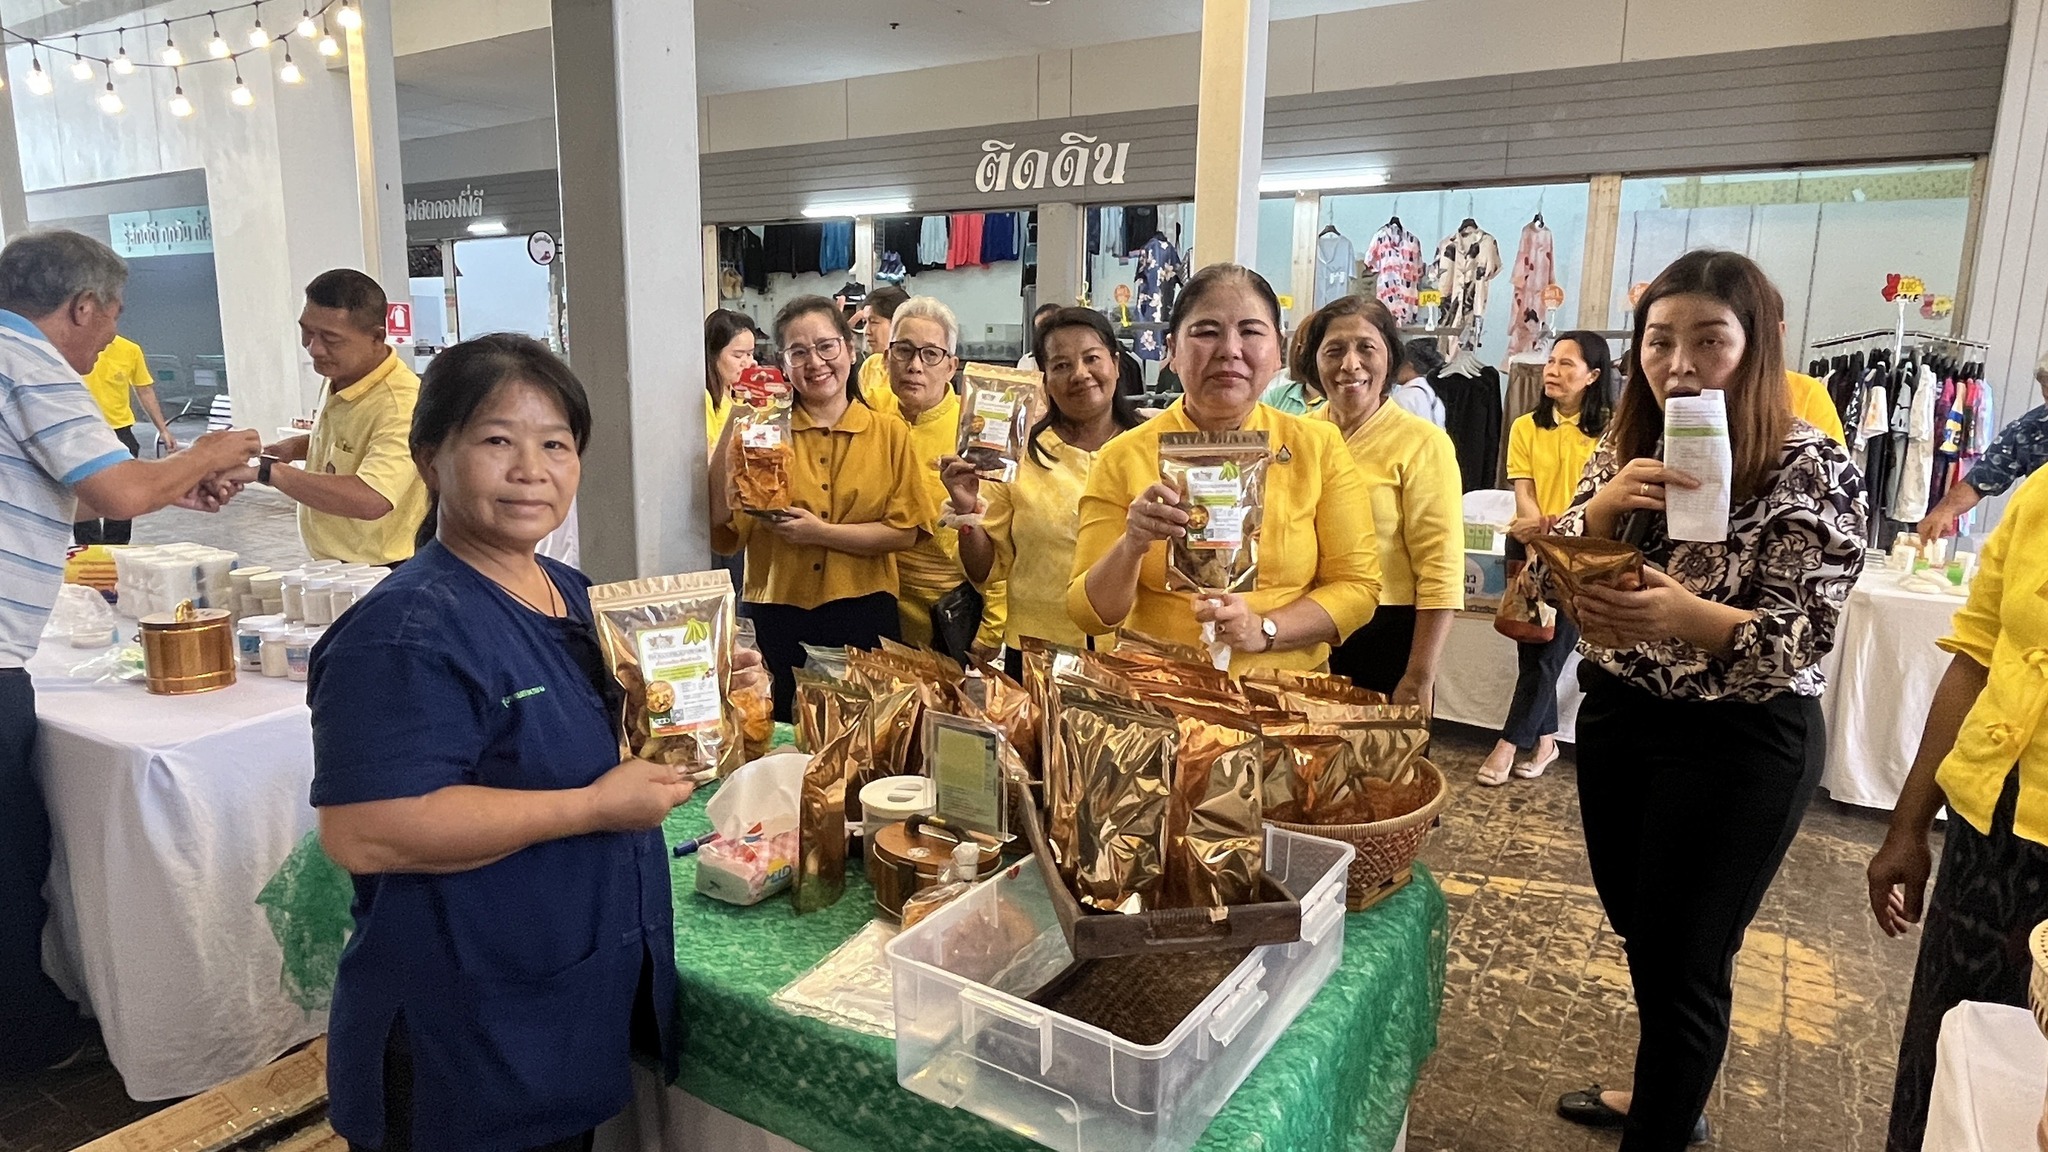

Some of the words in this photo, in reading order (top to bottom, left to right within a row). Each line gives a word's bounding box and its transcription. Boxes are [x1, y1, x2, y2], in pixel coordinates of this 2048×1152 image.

[975, 132, 1131, 193] ติดดิน
[405, 184, 484, 221] ฟสดคอฟฟี่ดี
